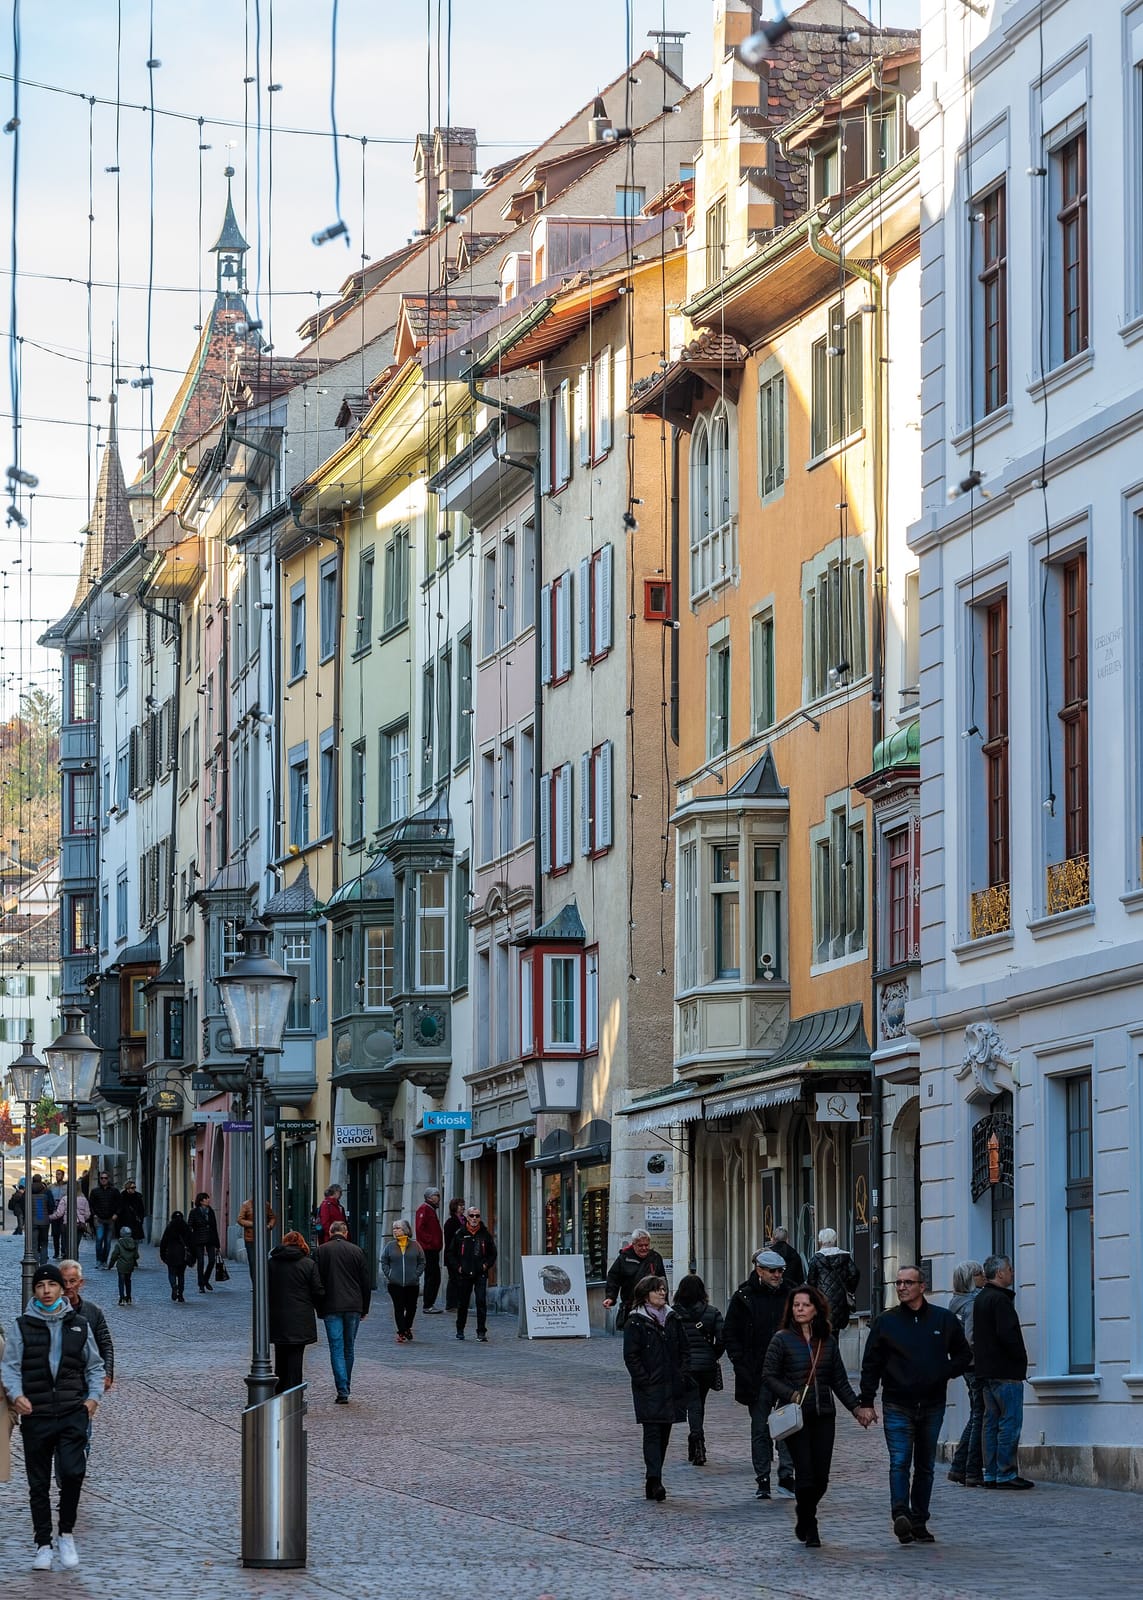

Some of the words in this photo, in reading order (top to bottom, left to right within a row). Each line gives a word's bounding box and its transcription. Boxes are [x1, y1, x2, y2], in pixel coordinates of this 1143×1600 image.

[436, 1115, 467, 1125] kiosk
[336, 1127, 373, 1137] Bücher
[336, 1136, 375, 1144] SCHOCH
[536, 1298, 576, 1306] MUSEUM
[532, 1305, 581, 1313] STEMMLER
